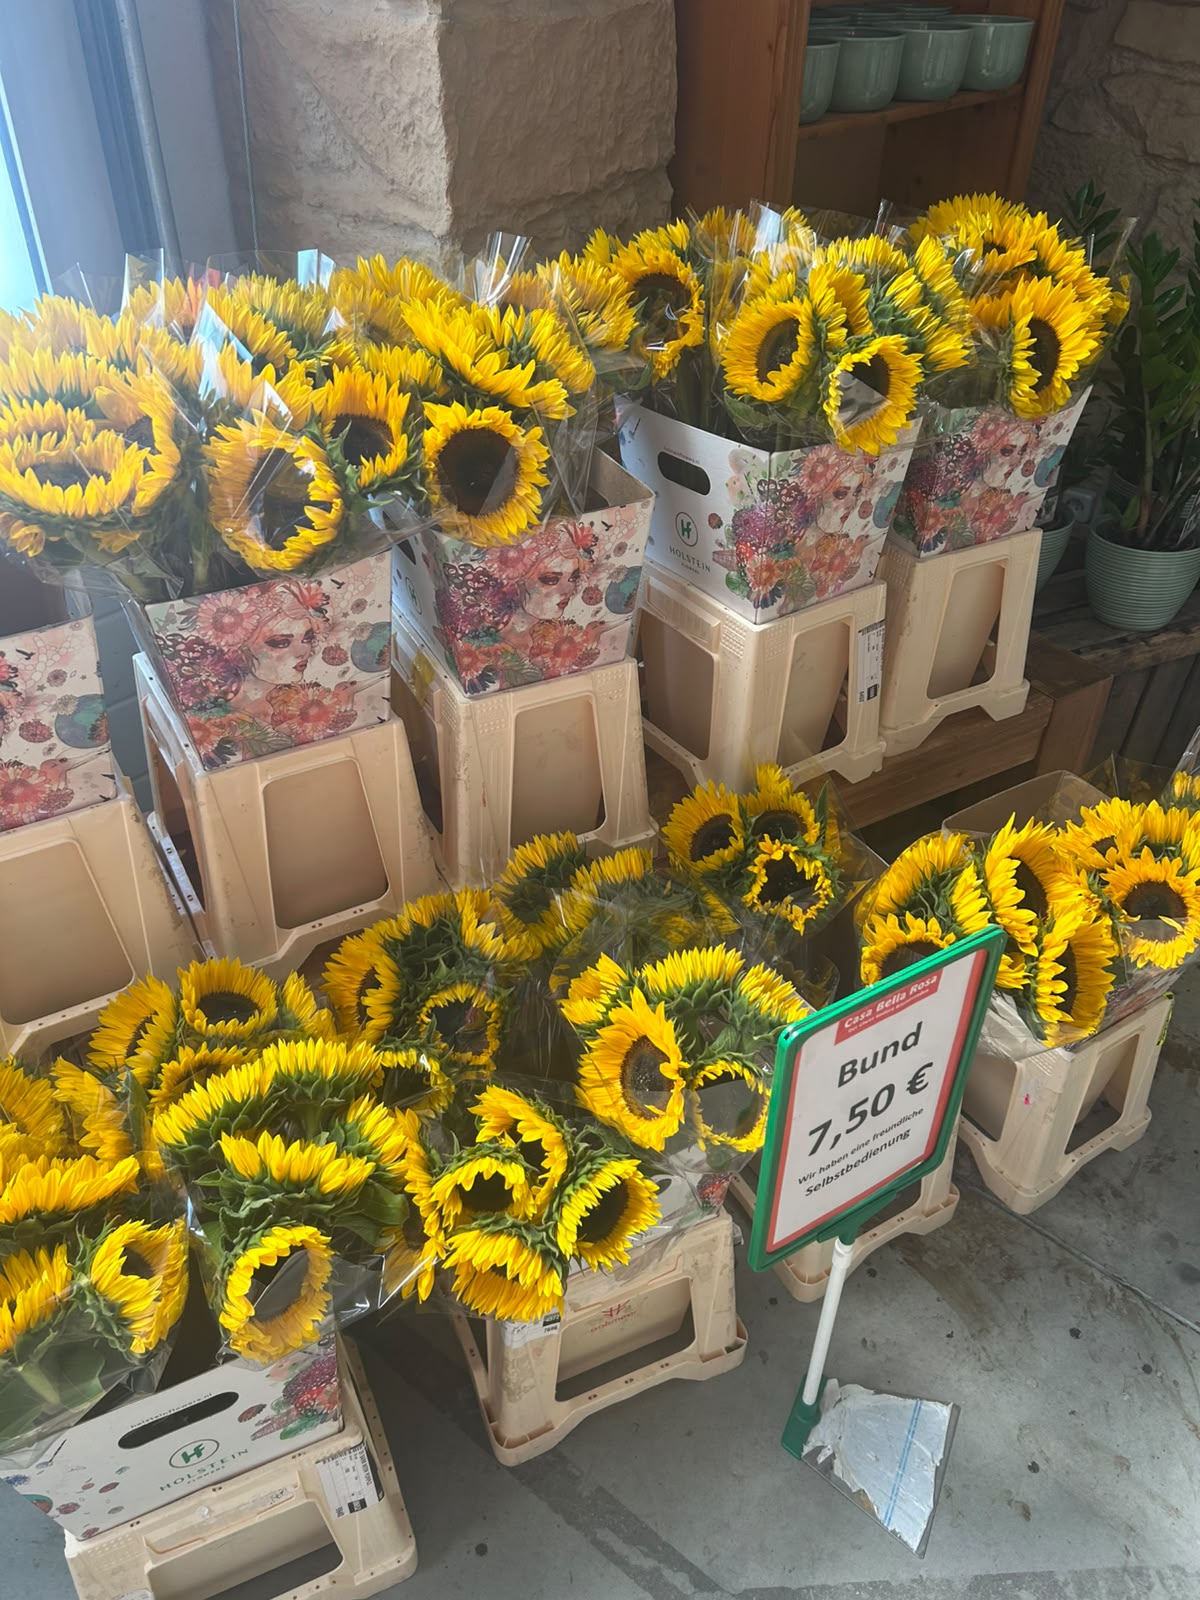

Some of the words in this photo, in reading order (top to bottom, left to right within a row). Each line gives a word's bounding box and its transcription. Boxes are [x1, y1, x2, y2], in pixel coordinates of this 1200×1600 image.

[669, 545, 711, 573] HOLSTEIN
[844, 1009, 873, 1028] Casa
[876, 992, 906, 1012] Bella
[909, 976, 937, 995] Rosa
[838, 1021, 923, 1088] Bund
[808, 1083, 895, 1156] 7,50
[906, 1062, 934, 1095] €
[798, 1171, 817, 1185] Wir
[819, 1153, 848, 1174] haben
[850, 1139, 871, 1155] eine
[872, 1108, 923, 1141] freundliche
[805, 1128, 911, 1197] Selbstbedienung
[160, 1448, 248, 1491] HOLSTEIN
